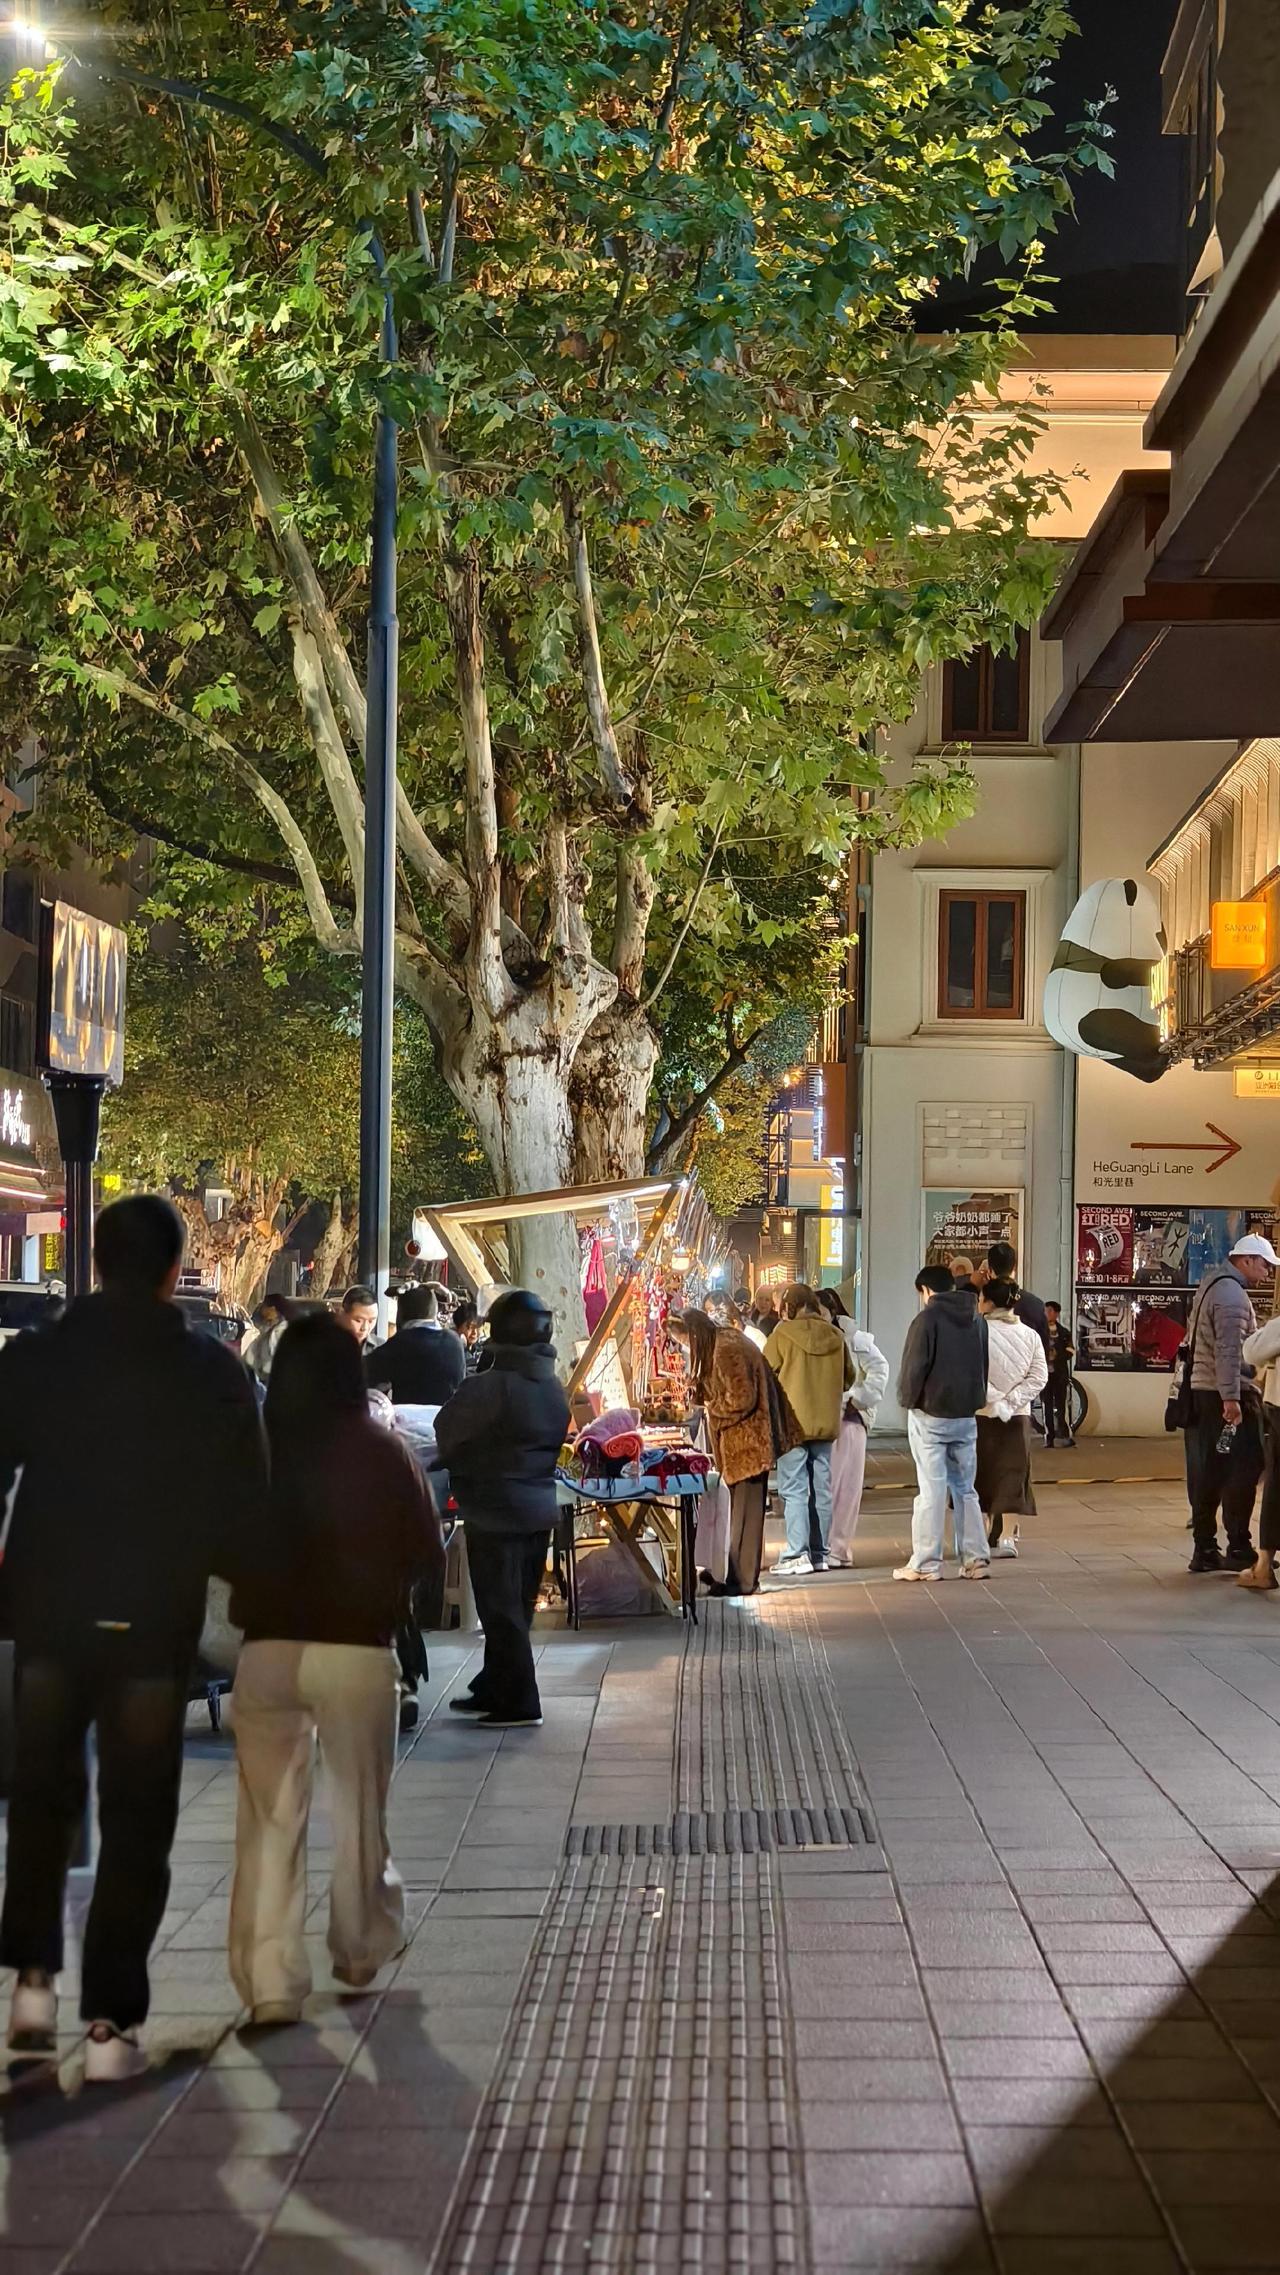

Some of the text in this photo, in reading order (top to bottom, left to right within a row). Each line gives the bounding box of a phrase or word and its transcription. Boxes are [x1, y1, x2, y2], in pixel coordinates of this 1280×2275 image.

[1093, 1161, 1194, 1176] HeGuangLi Lane
[1093, 1177, 1134, 1187] 和光里巷
[933, 1211, 1012, 1223] 爷爷奶奶都睡了
[1100, 1213, 1130, 1226] RED
[933, 1225, 1012, 1237] 大家都小声一点
[1102, 1233, 1119, 1248] RED
